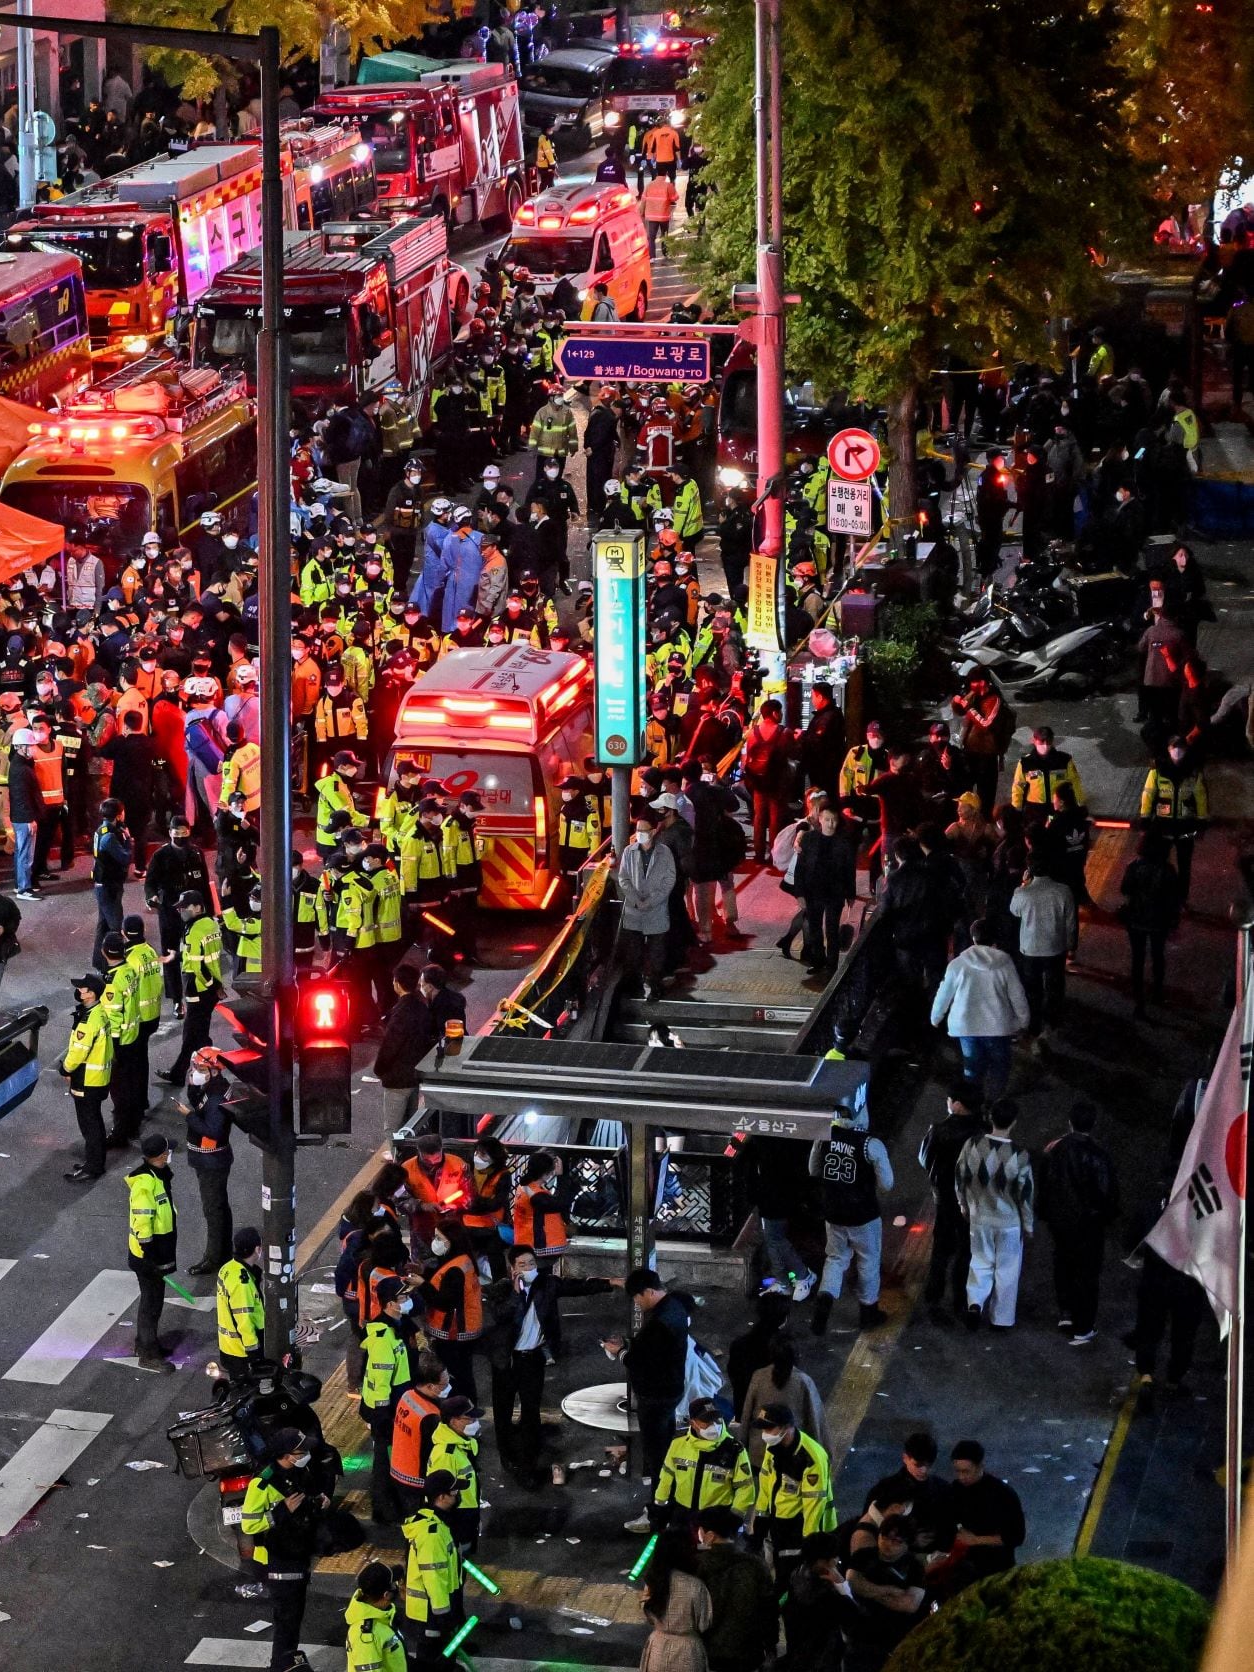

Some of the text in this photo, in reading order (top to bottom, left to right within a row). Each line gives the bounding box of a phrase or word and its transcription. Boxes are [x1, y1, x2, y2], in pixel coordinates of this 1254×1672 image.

[579, 350, 595, 359] 129
[652, 346, 703, 362] 보광로
[594, 365, 625, 376] 普光路
[633, 364, 703, 378] Bogwang-ro
[831, 486, 869, 502] 보행전용거리
[607, 741, 626, 750] 630
[758, 1119, 798, 1133] 용산구
[830, 1141, 856, 1157] PAYNE
[823, 1152, 857, 1184] 23
